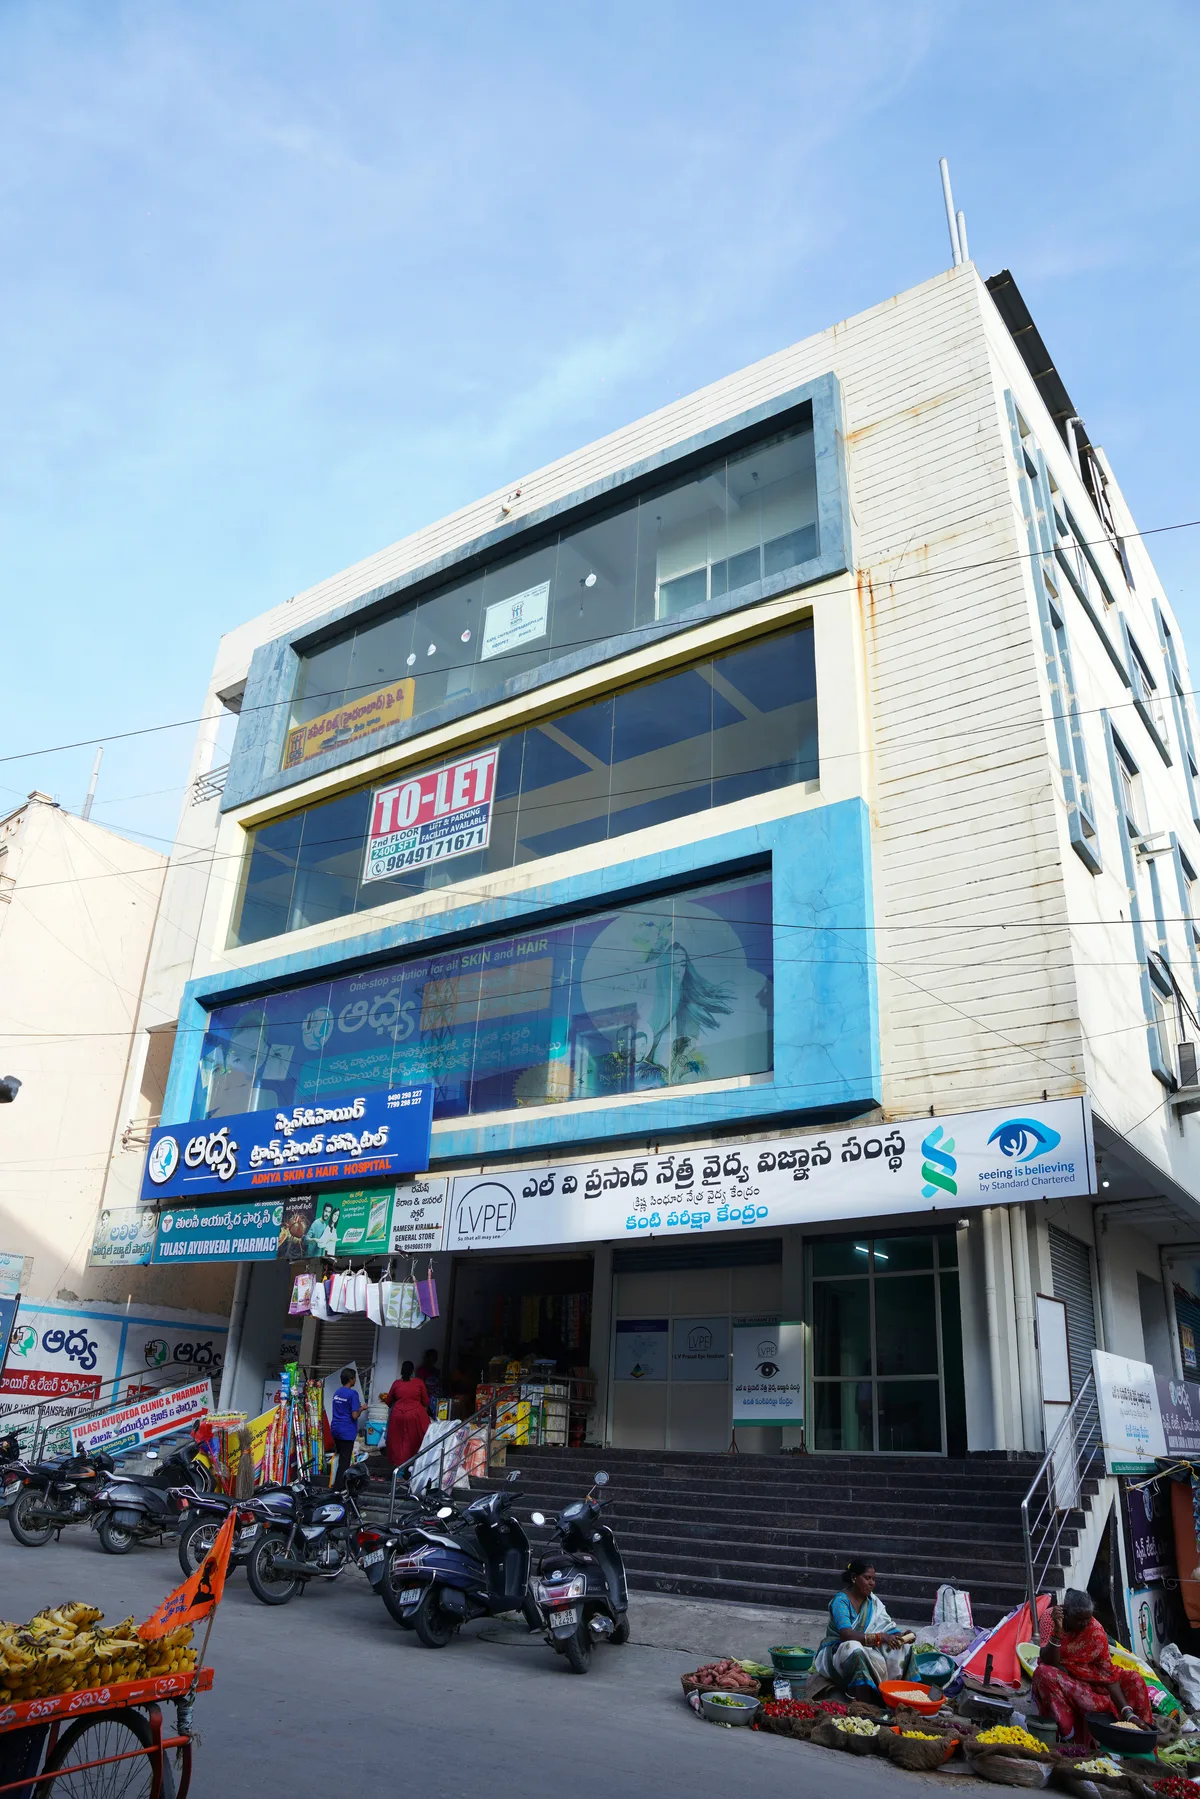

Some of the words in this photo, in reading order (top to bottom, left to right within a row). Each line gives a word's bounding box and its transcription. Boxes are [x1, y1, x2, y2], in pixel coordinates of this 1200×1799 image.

[377, 752, 495, 835] TO-LET
[421, 826, 450, 843] FACILITY
[450, 814, 487, 833] AVAILABLE
[429, 821, 442, 831] LIFT
[443, 818, 450, 826] &
[450, 807, 481, 824] PARKING
[371, 836, 389, 849] 2nd
[390, 827, 419, 845] FLOOR
[371, 843, 396, 859] 2400
[398, 837, 415, 852] SFT
[385, 827, 485, 872] 9849171671
[350, 977, 389, 993] One-stop
[390, 968, 428, 986] solution
[430, 961, 443, 974] for
[445, 959, 458, 971] all
[461, 950, 491, 968] SKIN
[493, 948, 513, 961] and
[516, 938, 548, 956] HAIR
[183, 1127, 239, 1181] ఆధ్య
[521, 1172, 557, 1199] ఎల్
[561, 1174, 579, 1195] వి
[584, 1161, 649, 1200] ప్రసాద్
[655, 1156, 695, 1190] నేత్ర
[702, 1150, 750, 1187] వైద్య
[757, 1140, 832, 1181] విజ్ఞాన
[840, 1130, 907, 1174] సంస్థ
[251, 1172, 281, 1185] ADHYA
[283, 1170, 305, 1182] SKIN
[306, 1168, 313, 1178] &
[315, 1165, 339, 1177] HAIR
[343, 1157, 392, 1175] HOSPITAL
[978, 1167, 1013, 1182] seeing
[1014, 1165, 1024, 1177] is
[1024, 1160, 1075, 1178] believing
[979, 1181, 990, 1192] by
[991, 1177, 1029, 1190] Standard
[1030, 1172, 1075, 1187] Chartered
[411, 1182, 430, 1194] రమేష్
[686, 1189, 704, 1205] నేత్ర
[707, 1188, 727, 1204] వైద్య
[729, 1185, 760, 1200] కేంద్రం
[413, 1197, 420, 1205] &
[175, 1214, 199, 1229] తులసి
[200, 1211, 241, 1230] ఆయుర్వేద
[393, 1224, 415, 1233] RAMESH
[415, 1222, 434, 1231] KIRANA
[625, 1211, 661, 1230] కంటి
[666, 1209, 711, 1230] పరీక్షా
[716, 1203, 769, 1225] కేంద్రం
[159, 1240, 187, 1257] TULASI
[187, 1239, 230, 1255] AYURVEDA
[394, 1233, 418, 1242] GENERAL
[418, 1232, 436, 1240] STORE
[41, 1328, 99, 1371] ఆధ్య
[29, 1379, 36, 1391] &
[36, 1375, 59, 1391] లేజర్
[0, 1402, 13, 1414] KIN
[72, 1423, 101, 1439] TULASI
[101, 1409, 140, 1429] AYURVEDA
[140, 1400, 165, 1414] CLINIC
[166, 1397, 171, 1405] &
[171, 1381, 209, 1402] PHARMACY
[89, 1430, 112, 1446] తులసి
